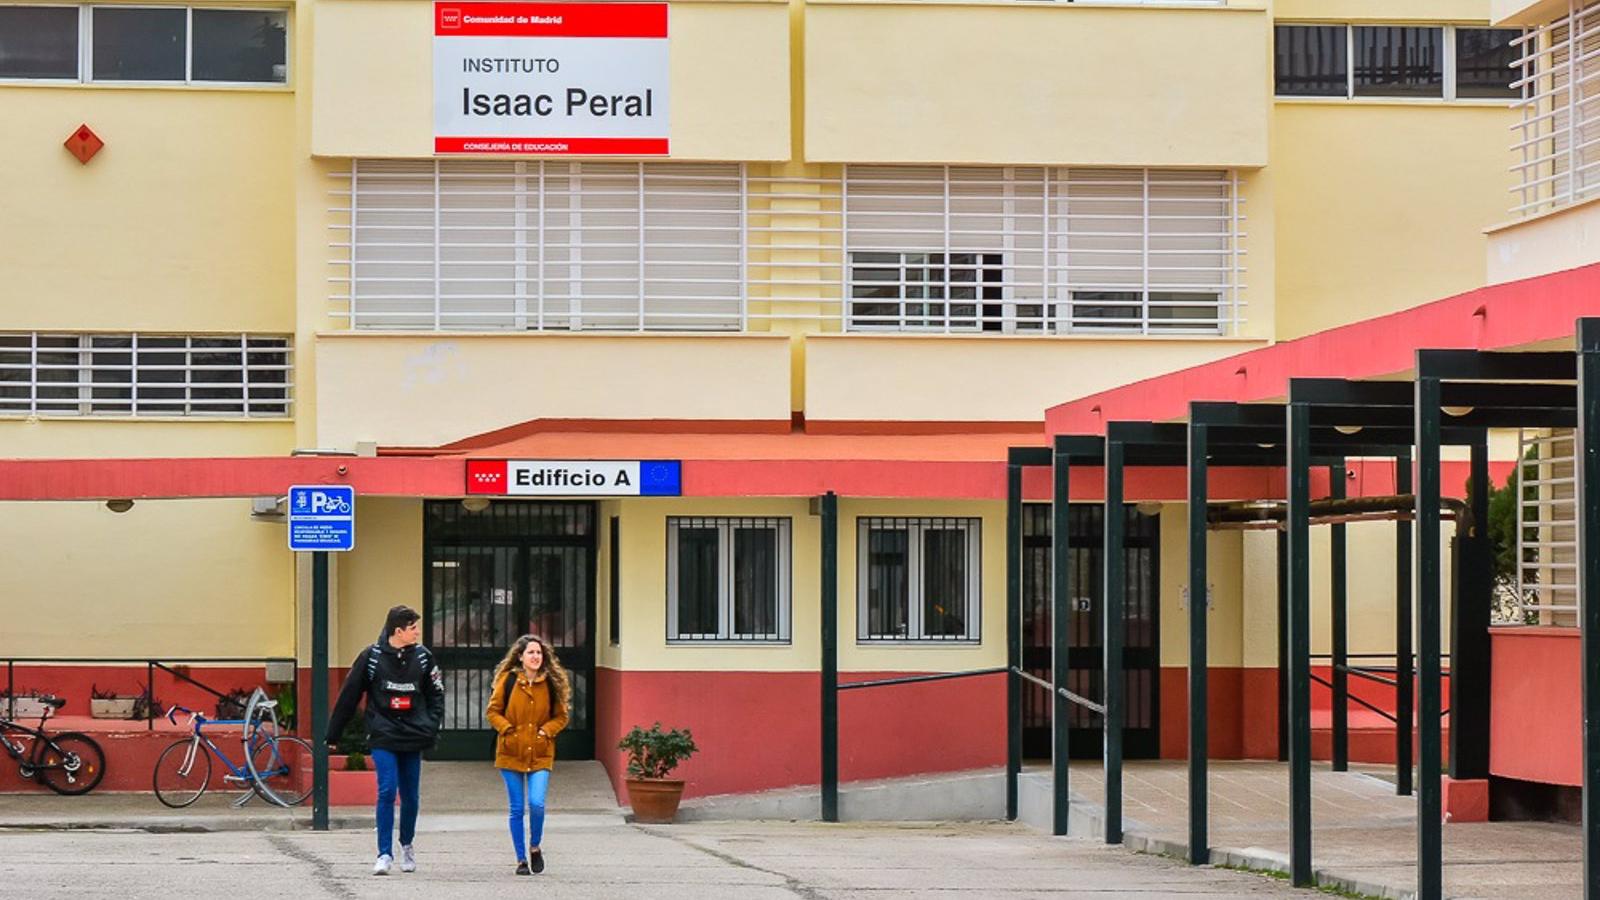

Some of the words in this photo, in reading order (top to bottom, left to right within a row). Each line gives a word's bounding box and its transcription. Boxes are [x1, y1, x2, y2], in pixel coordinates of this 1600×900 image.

[463, 15, 515, 24] Comunidad
[516, 15, 528, 24] de
[530, 15, 563, 25] Madrid
[463, 57, 560, 74] INSTITUTO
[463, 87, 553, 117] Isaac
[566, 87, 652, 117] Peral
[511, 143, 523, 152] DE
[516, 468, 606, 487] Edificio
[614, 469, 631, 487] A
[311, 491, 327, 513] P
